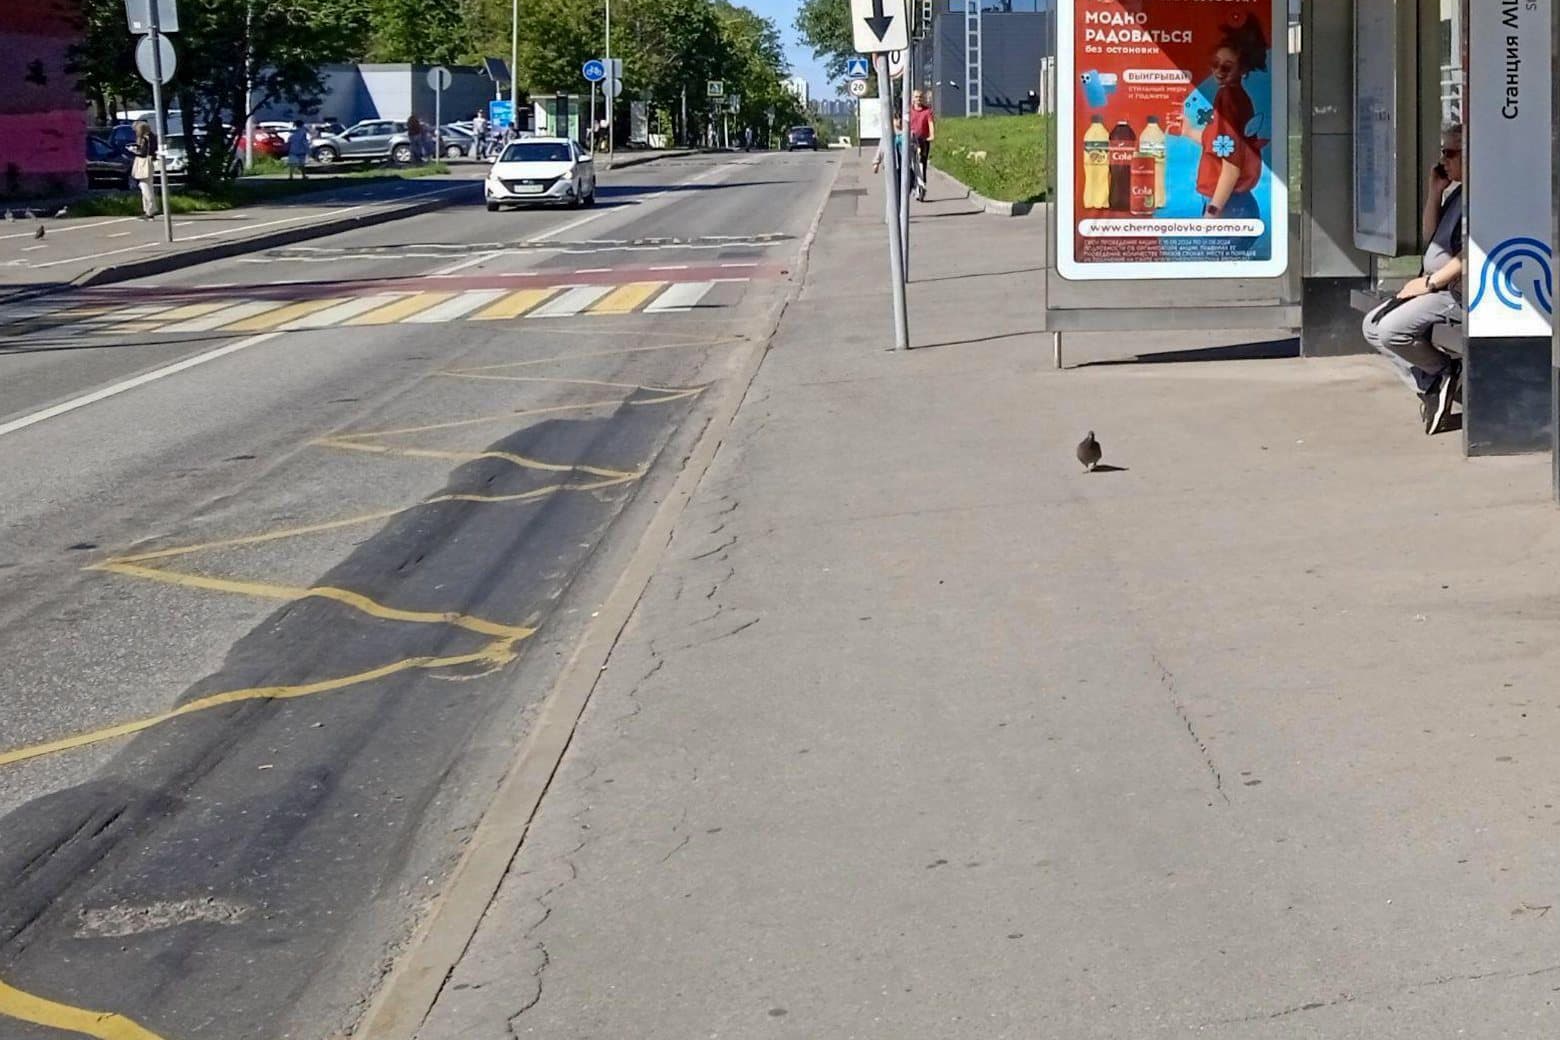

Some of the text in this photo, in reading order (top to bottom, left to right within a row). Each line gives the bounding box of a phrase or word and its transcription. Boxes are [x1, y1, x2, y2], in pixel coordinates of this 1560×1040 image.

[1085, 11, 1148, 27] МОДНО
[1085, 28, 1193, 44] РАДОВАТЬСЯ
[1085, 45, 1160, 54] без остановки
[1501, 35, 1522, 120] Станция
[853, 83, 864, 91] 20
